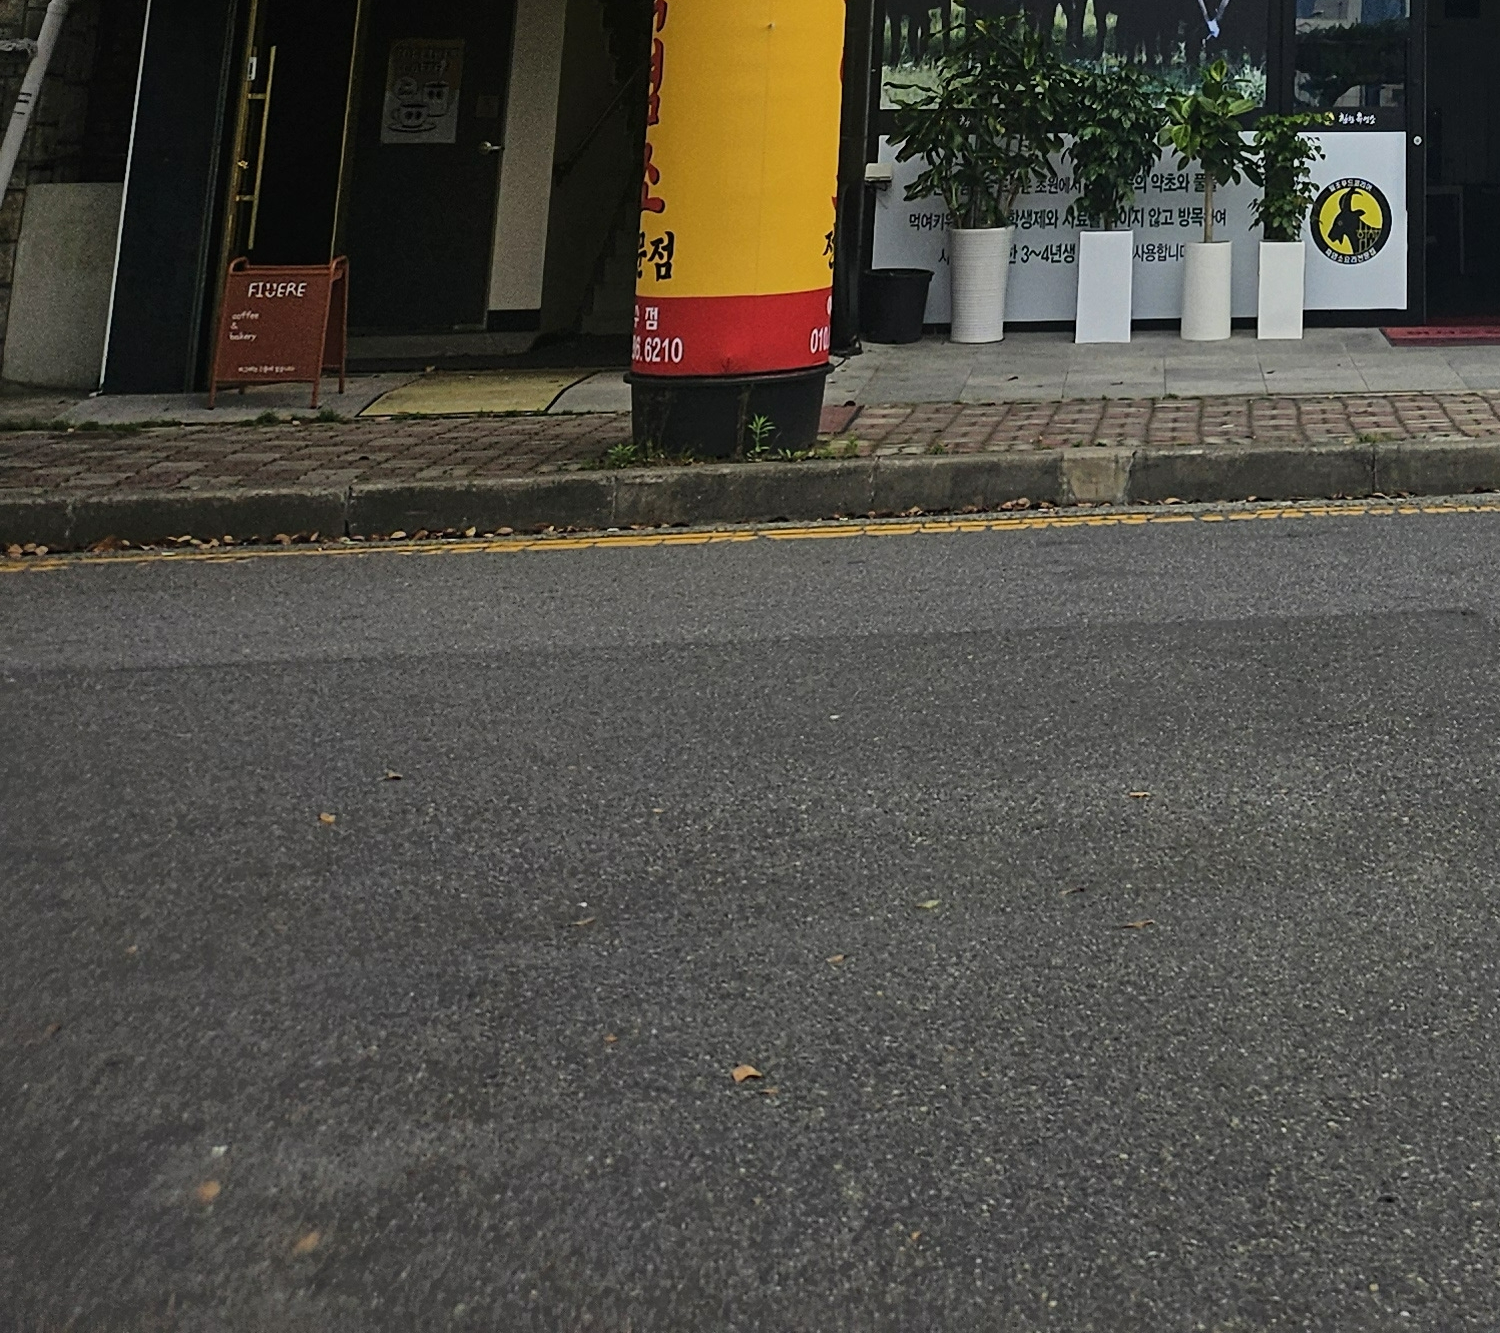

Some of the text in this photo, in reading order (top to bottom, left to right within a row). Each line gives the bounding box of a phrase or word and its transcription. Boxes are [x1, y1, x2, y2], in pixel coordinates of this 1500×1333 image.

[1151, 172, 1190, 193] 약초와
[1148, 208, 1175, 228] 않고
[1020, 243, 1076, 264] 3~4년생
[231, 310, 260, 320] coffee
